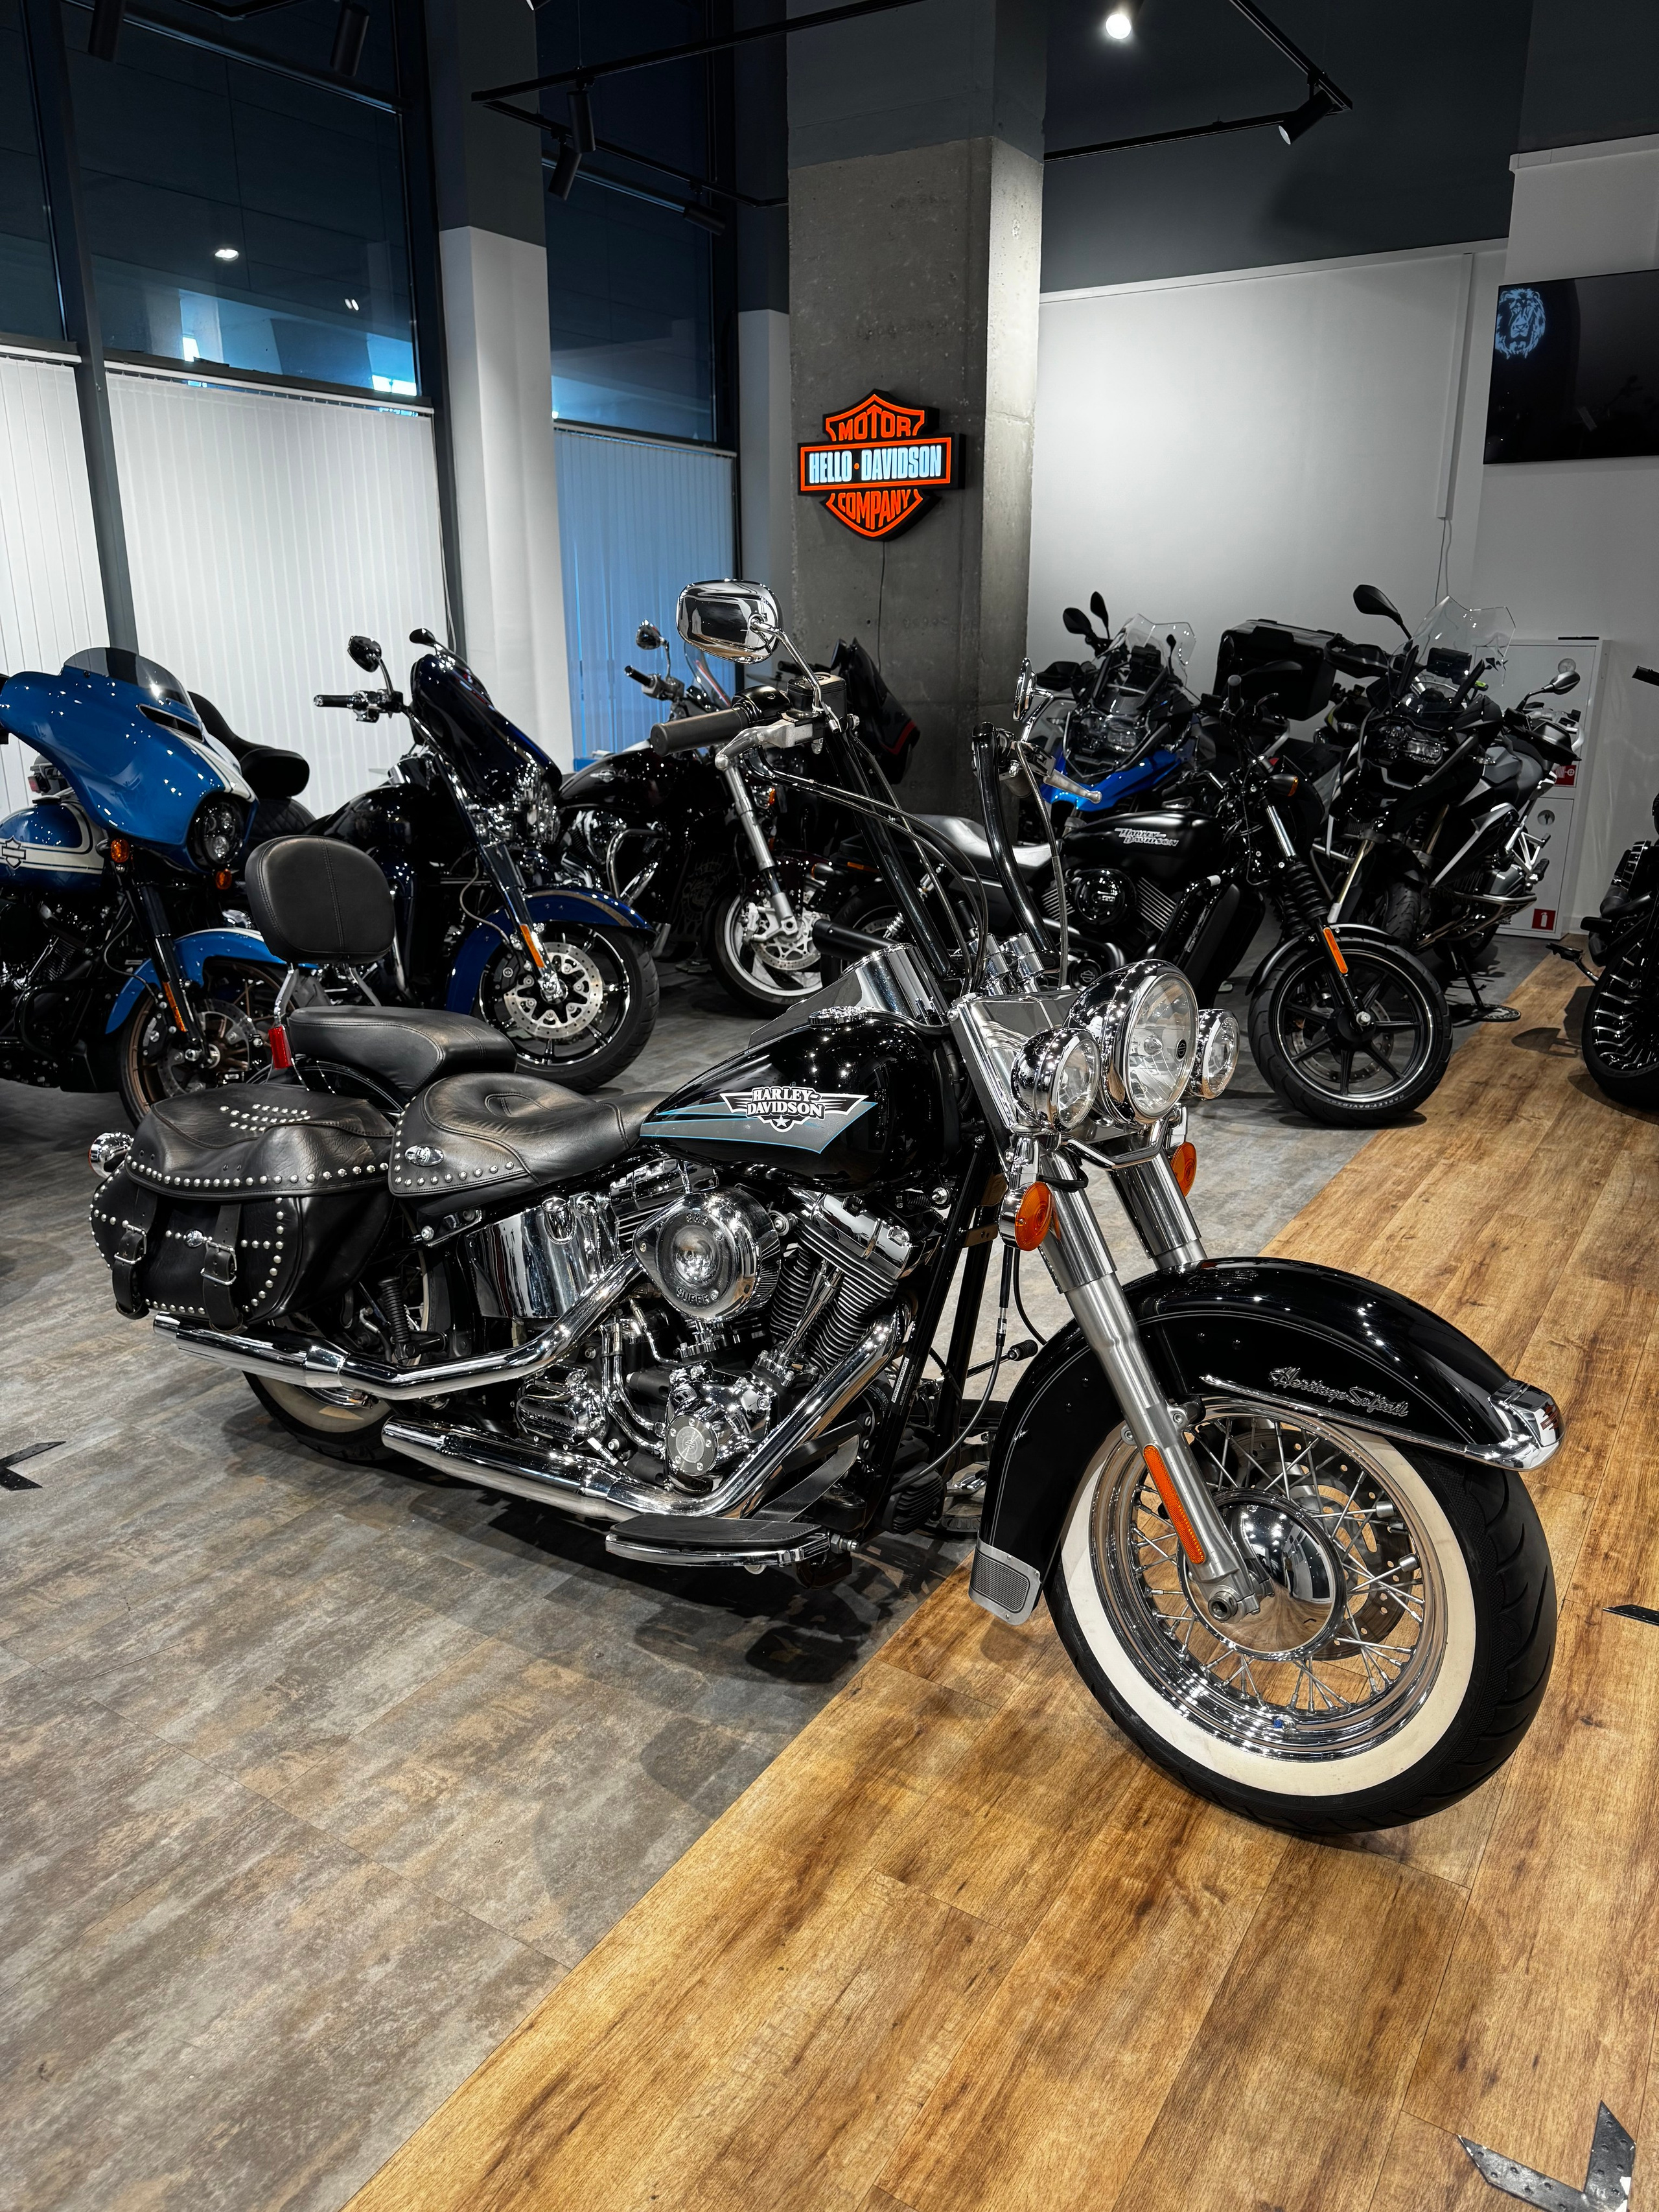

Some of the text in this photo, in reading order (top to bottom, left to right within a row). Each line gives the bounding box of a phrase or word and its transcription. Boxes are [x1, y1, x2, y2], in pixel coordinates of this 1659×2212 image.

[839, 404, 911, 441] MOTOR
[809, 445, 942, 483] HELLO DAVIDSON
[838, 489, 911, 530] COMPANY
[747, 1101, 824, 1118] DAVIDSON
[1269, 1366, 1409, 1417] Heritage Softail
